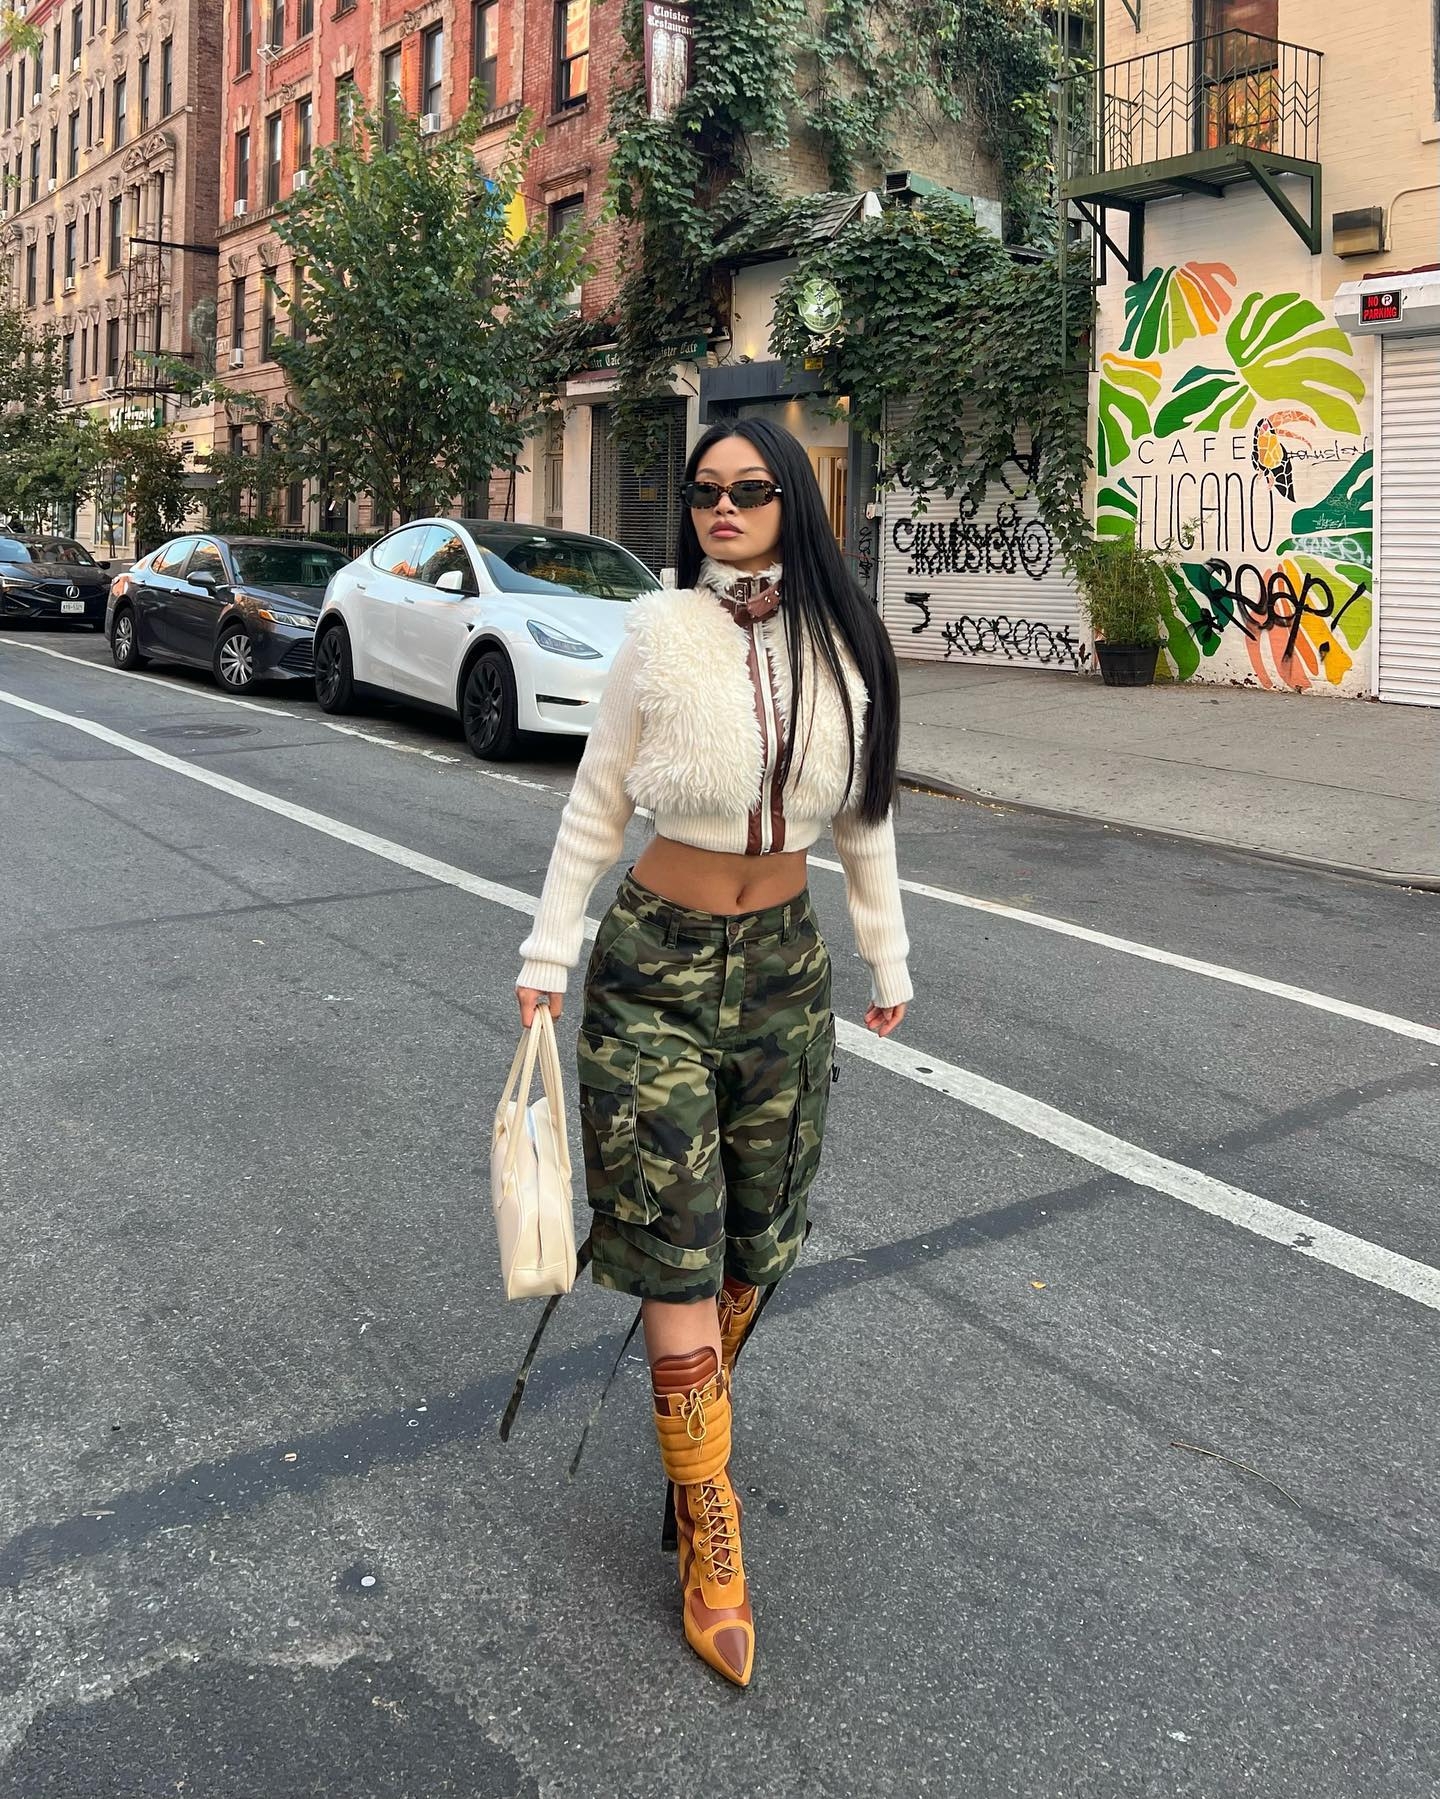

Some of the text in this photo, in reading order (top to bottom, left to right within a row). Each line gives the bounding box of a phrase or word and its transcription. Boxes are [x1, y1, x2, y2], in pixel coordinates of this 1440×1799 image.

[653, 5, 689, 23] Cloister
[1367, 296, 1379, 307] NO
[1363, 306, 1397, 320] PARKING
[1138, 436, 1246, 465] CAFE
